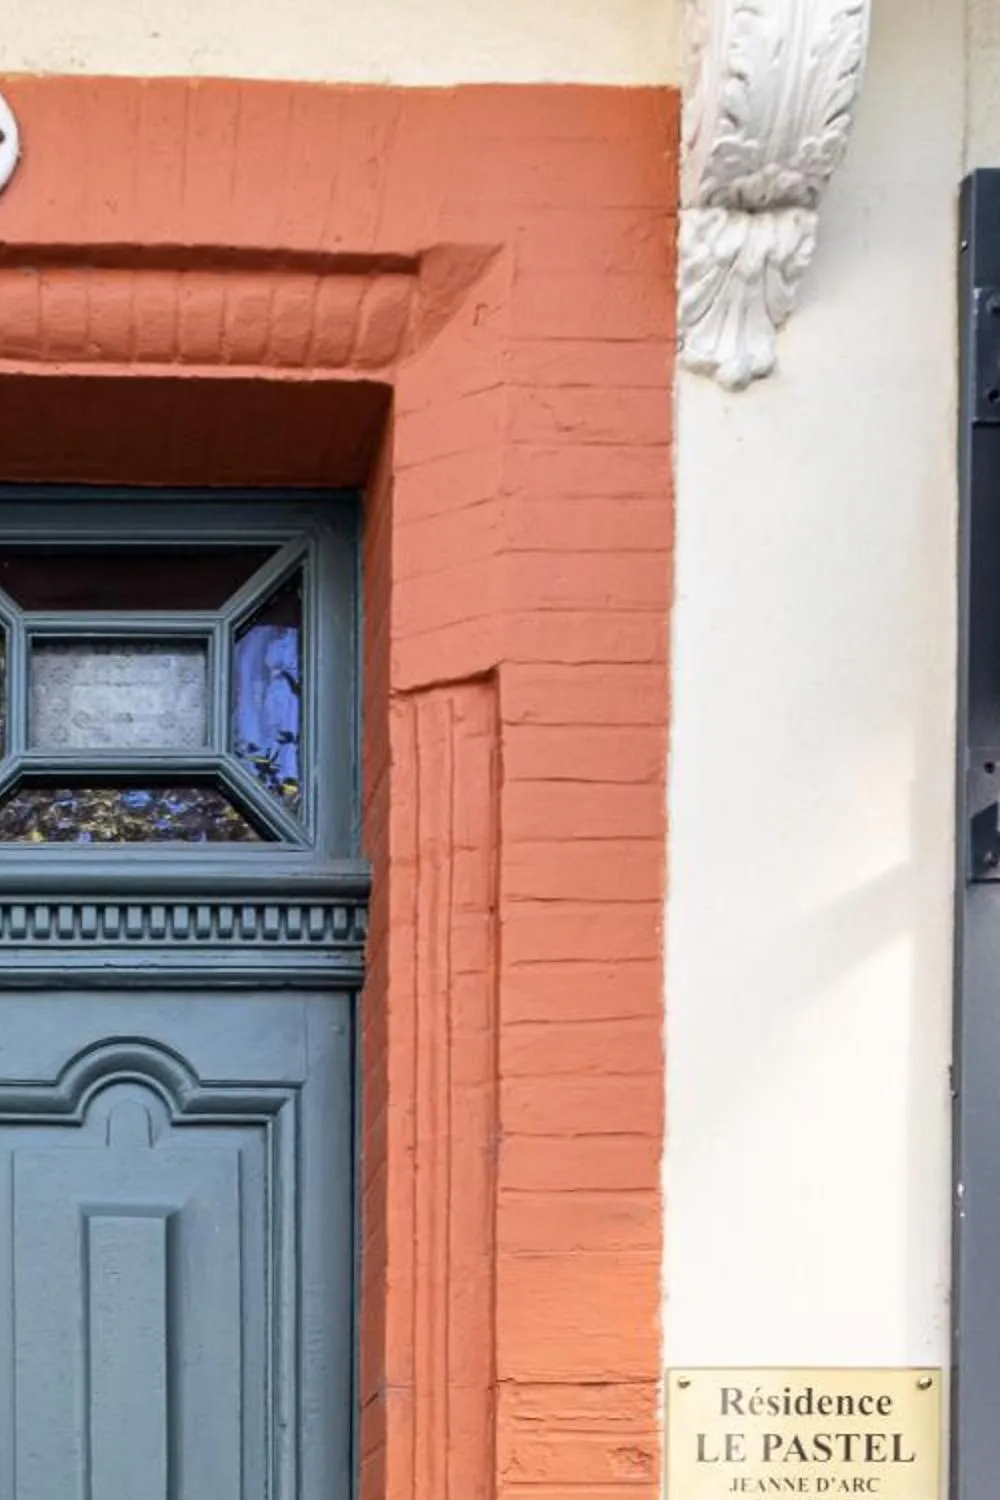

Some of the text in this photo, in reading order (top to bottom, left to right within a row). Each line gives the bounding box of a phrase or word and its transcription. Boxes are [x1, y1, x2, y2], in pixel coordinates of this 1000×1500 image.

[720, 1387, 893, 1416] Résidence
[696, 1433, 916, 1463] LE PASTEL
[729, 1477, 881, 1493] JEANNE D'ARC
